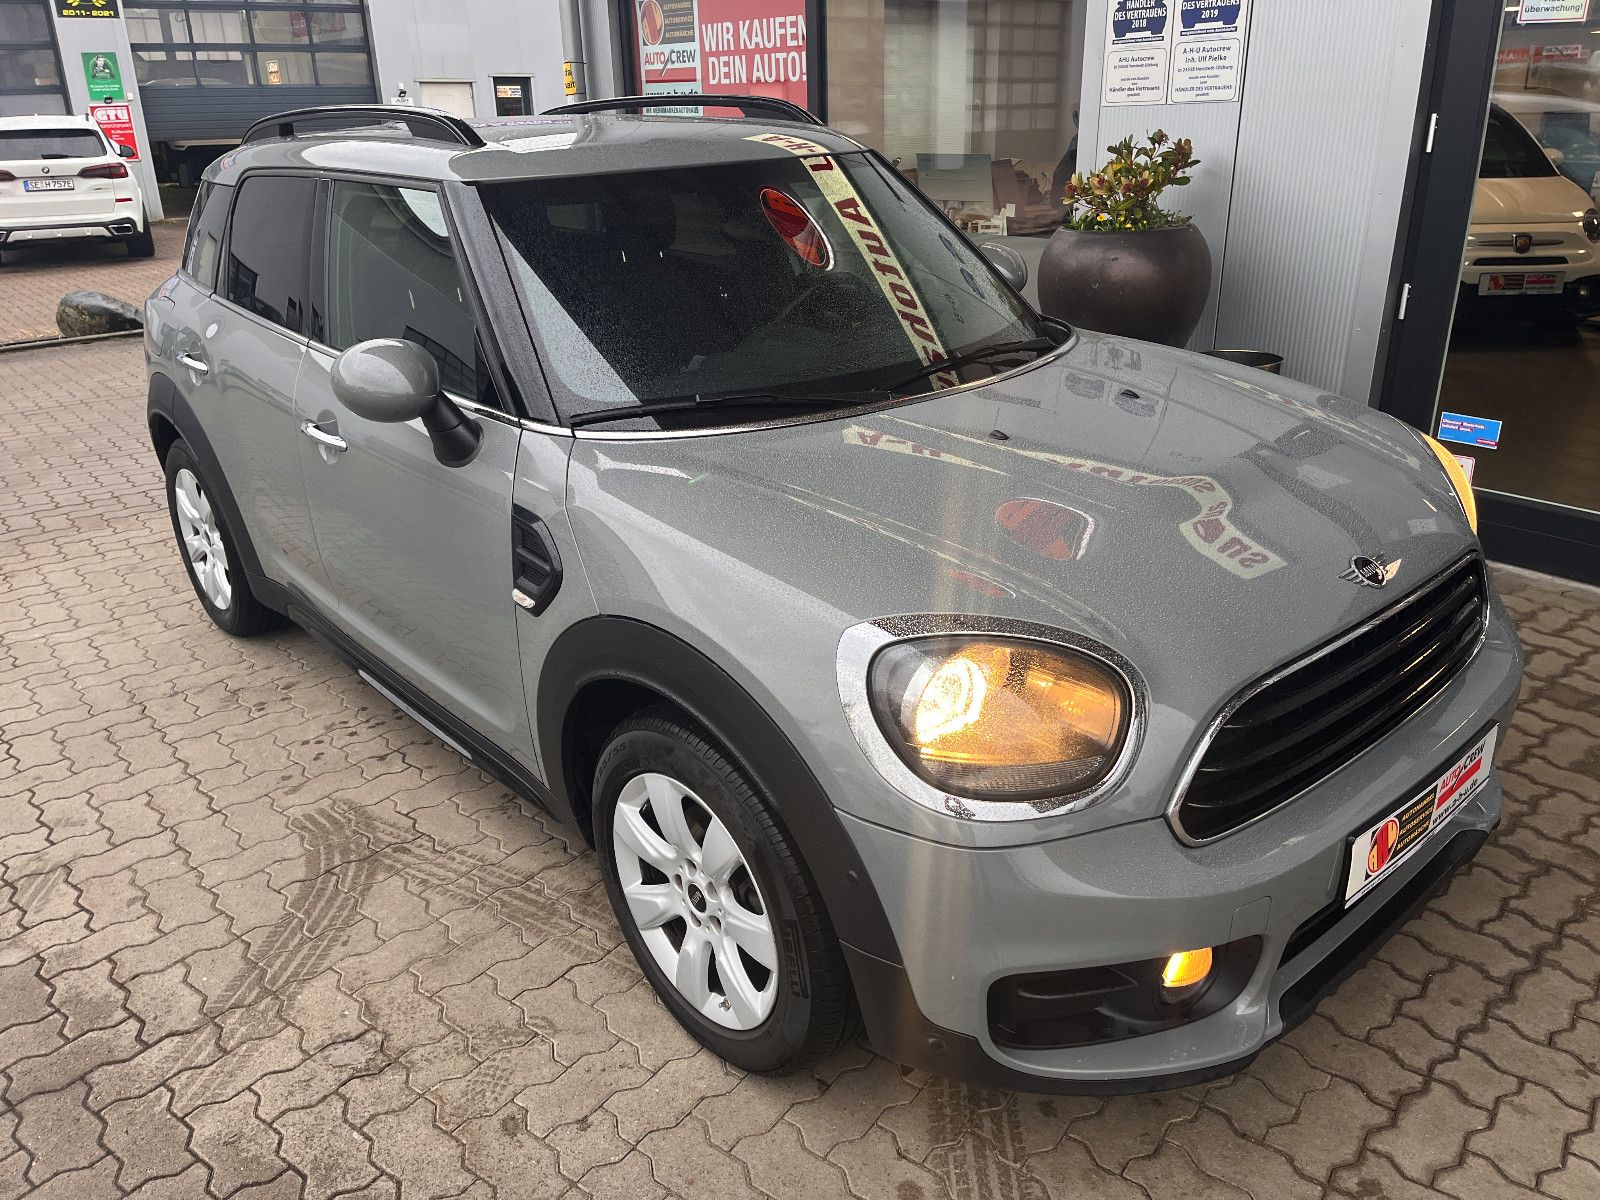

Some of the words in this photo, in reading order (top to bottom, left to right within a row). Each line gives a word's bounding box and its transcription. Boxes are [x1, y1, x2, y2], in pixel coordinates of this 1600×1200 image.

[1182, 2, 1196, 10] DES
[1524, 4, 1583, 14] überwachung!
[1114, 11, 1126, 21] DES
[1126, 7, 1167, 20] VERTRAUENS
[1201, 9, 1219, 18] 2019
[1131, 19, 1147, 28] 2018
[702, 21, 734, 52] WIR
[1201, 45, 1231, 53] Autocrew
[708, 54, 748, 85] DEIN
[752, 51, 807, 84] AUTO!
